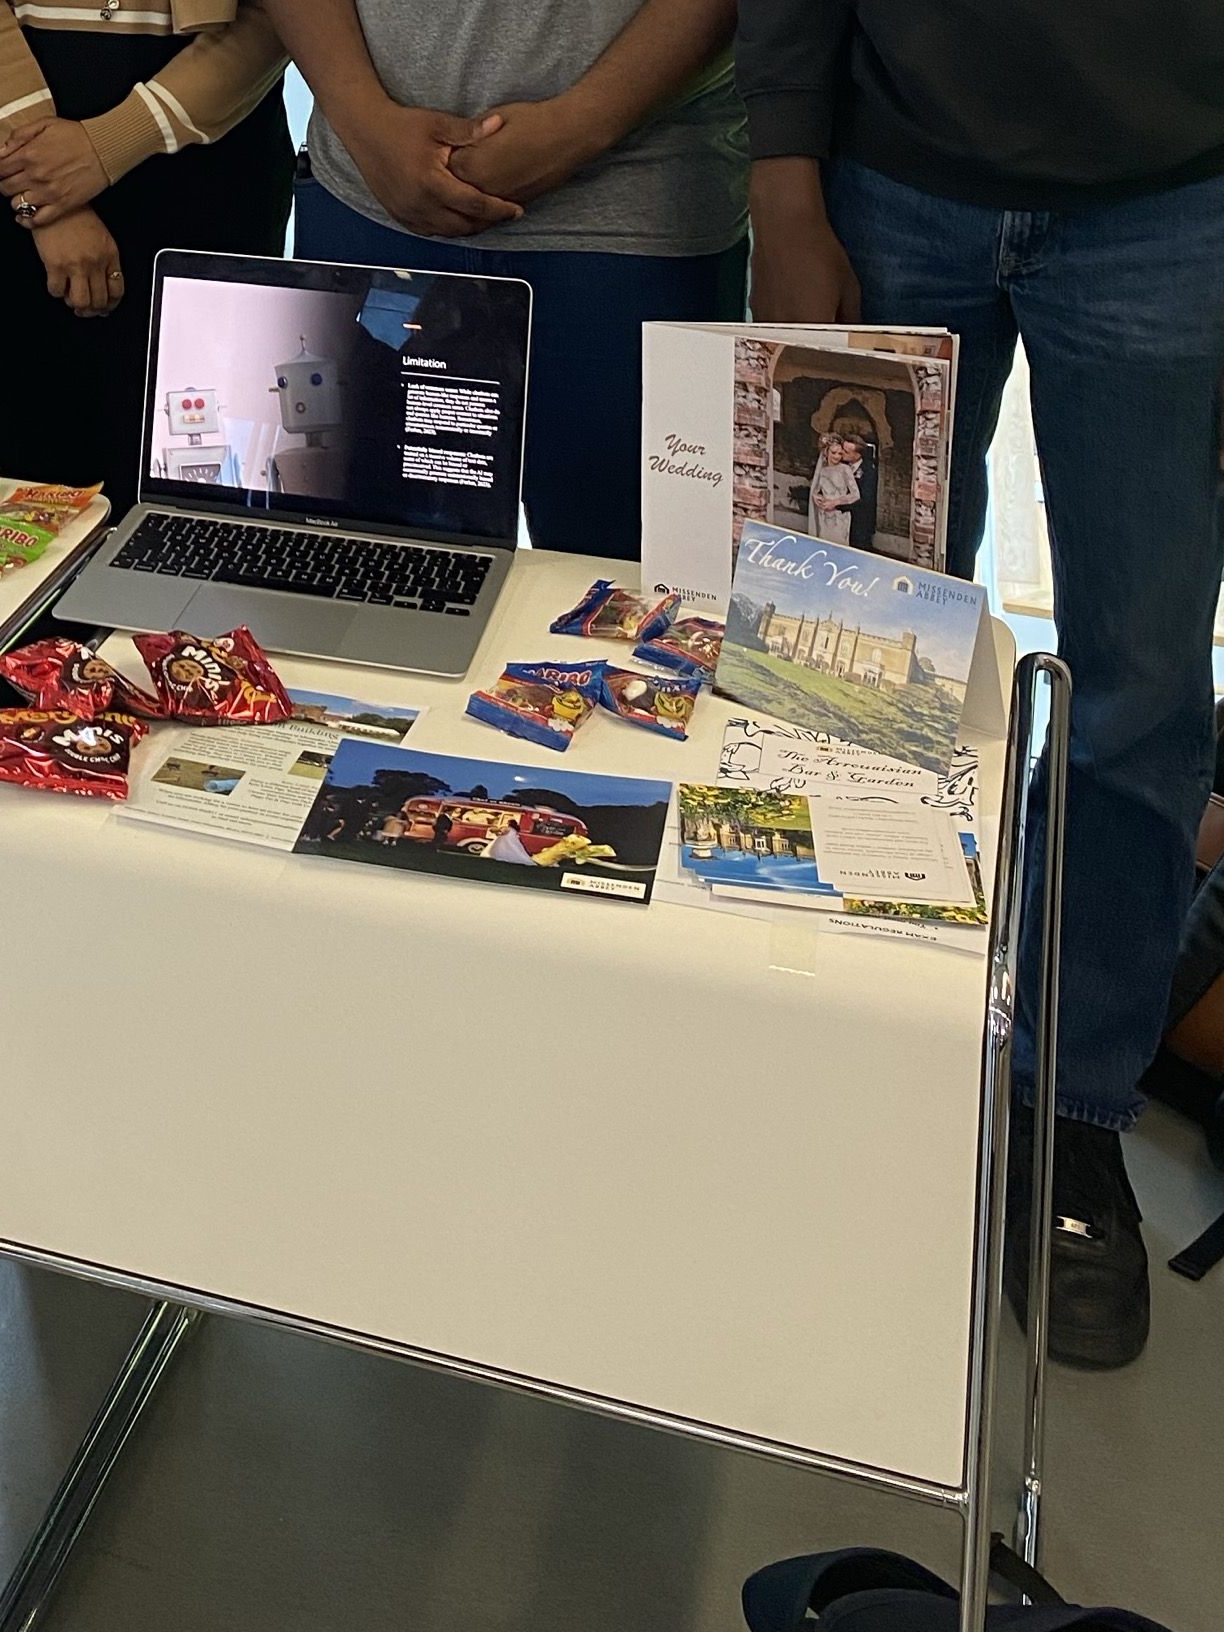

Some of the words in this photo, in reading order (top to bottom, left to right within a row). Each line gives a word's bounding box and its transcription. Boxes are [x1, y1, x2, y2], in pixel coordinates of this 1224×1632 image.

[402, 356, 447, 369] Limitation
[665, 434, 706, 456] Your
[649, 456, 723, 487] Wedding
[745, 535, 827, 579] Thank
[823, 561, 879, 597] You!
[672, 587, 716, 600] MISSENDEN
[916, 593, 947, 605] ABBEY
[918, 582, 977, 605] MISSENDEN
[779, 750, 809, 762] The
[782, 763, 822, 776] Bar
[826, 771, 841, 781] &
[848, 771, 914, 787] Garden
[829, 918, 903, 935] REGULATIONS
[906, 931, 937, 941] EXAM
